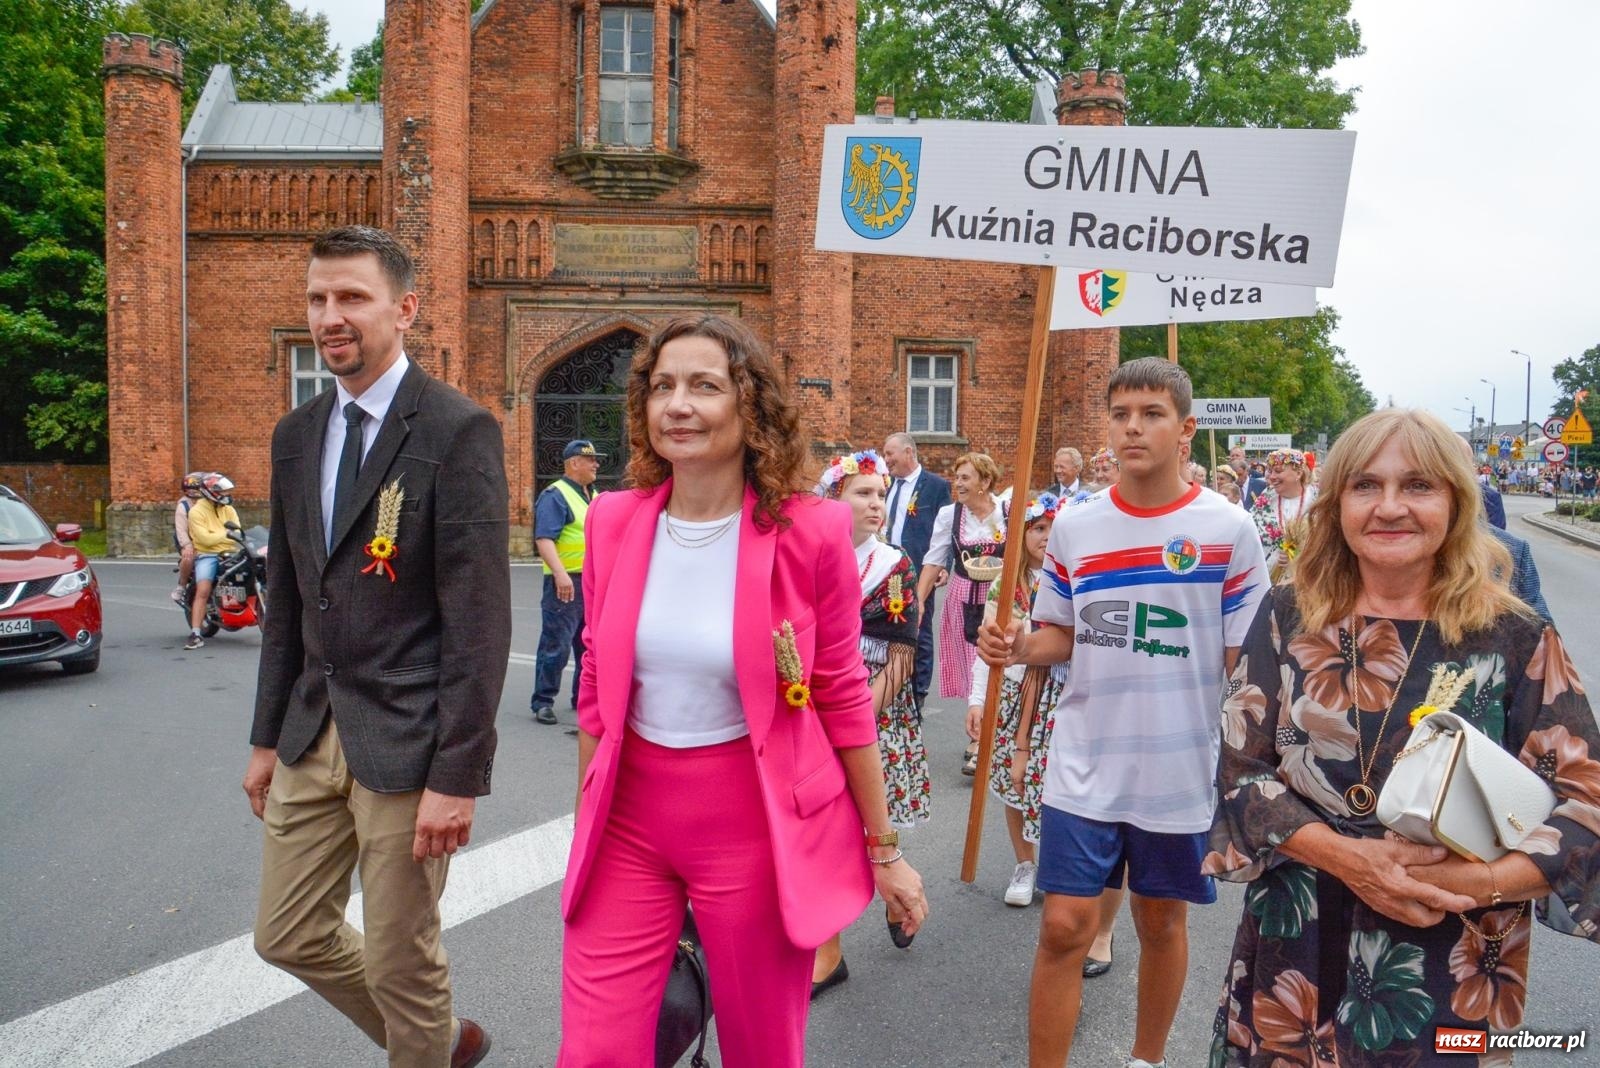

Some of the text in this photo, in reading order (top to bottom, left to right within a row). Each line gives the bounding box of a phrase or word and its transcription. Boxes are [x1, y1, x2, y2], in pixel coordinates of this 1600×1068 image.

[1024, 144, 1210, 197] GMINA
[931, 204, 1311, 264] Kuźnia Raciborska
[1170, 284, 1262, 312] Nędza
[1206, 403, 1246, 413] GMINA
[1196, 415, 1268, 425] etrowice Wielkie
[1547, 423, 1564, 434] 40
